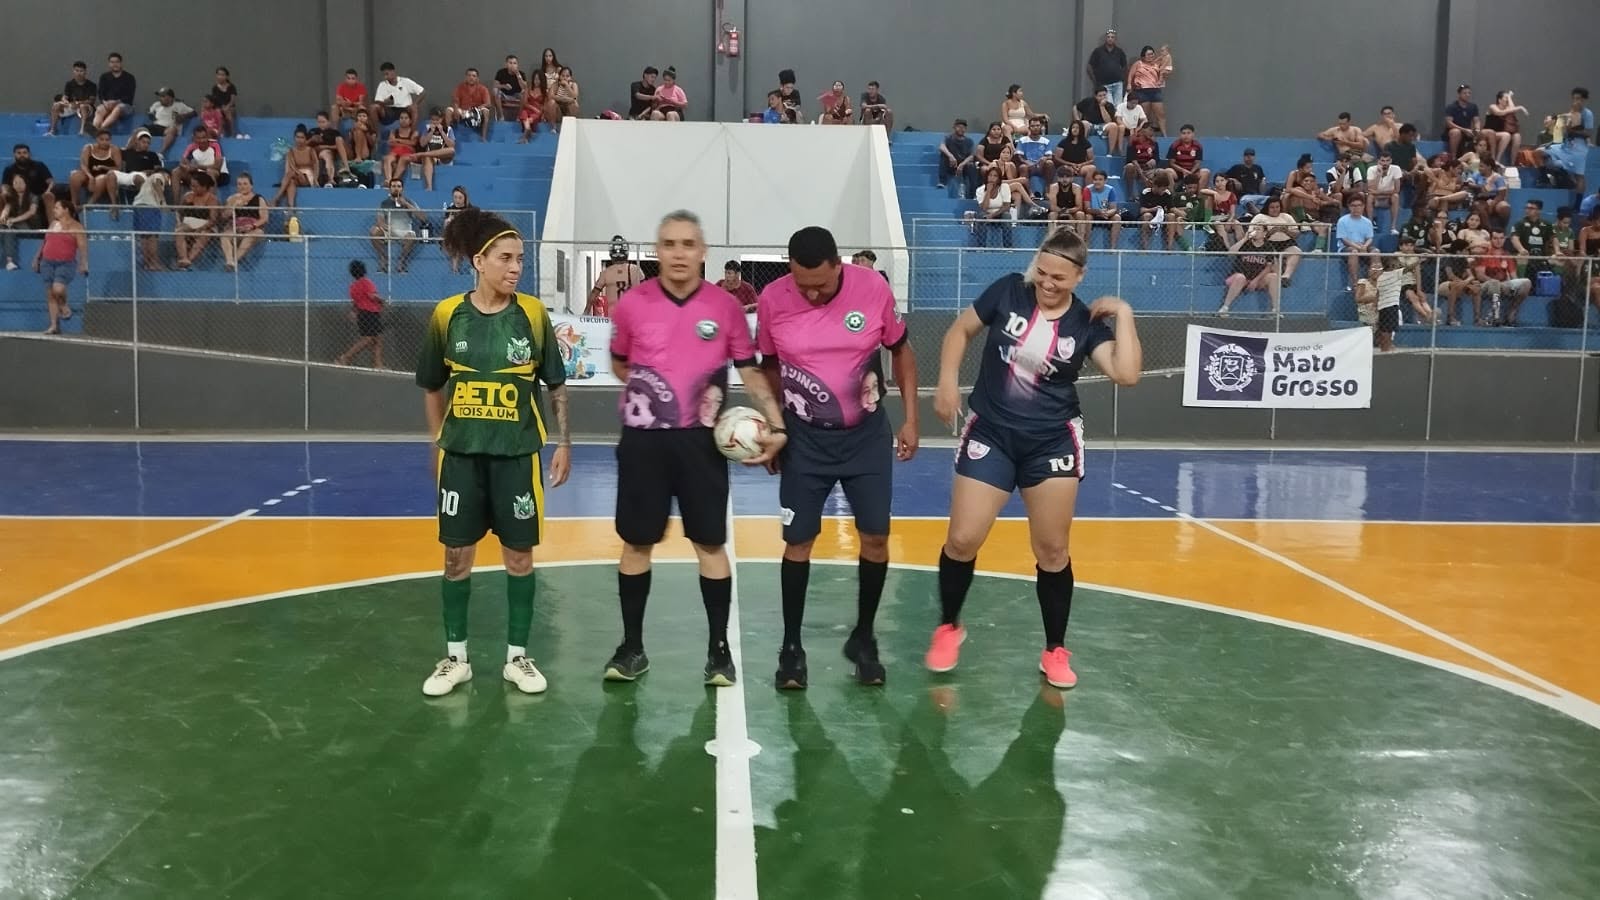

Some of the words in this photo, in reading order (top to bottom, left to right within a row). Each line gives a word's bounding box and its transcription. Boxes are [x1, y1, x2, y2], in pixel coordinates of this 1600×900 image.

[1005, 312, 1028, 337] 10
[1274, 344, 1311, 352] Governo
[1272, 352, 1336, 373] Mato
[453, 381, 518, 408] BETO
[1272, 375, 1358, 397] Grosso
[485, 408, 494, 417] A
[497, 409, 516, 419] UM
[1048, 454, 1075, 472] 10
[441, 487, 460, 517] 10
